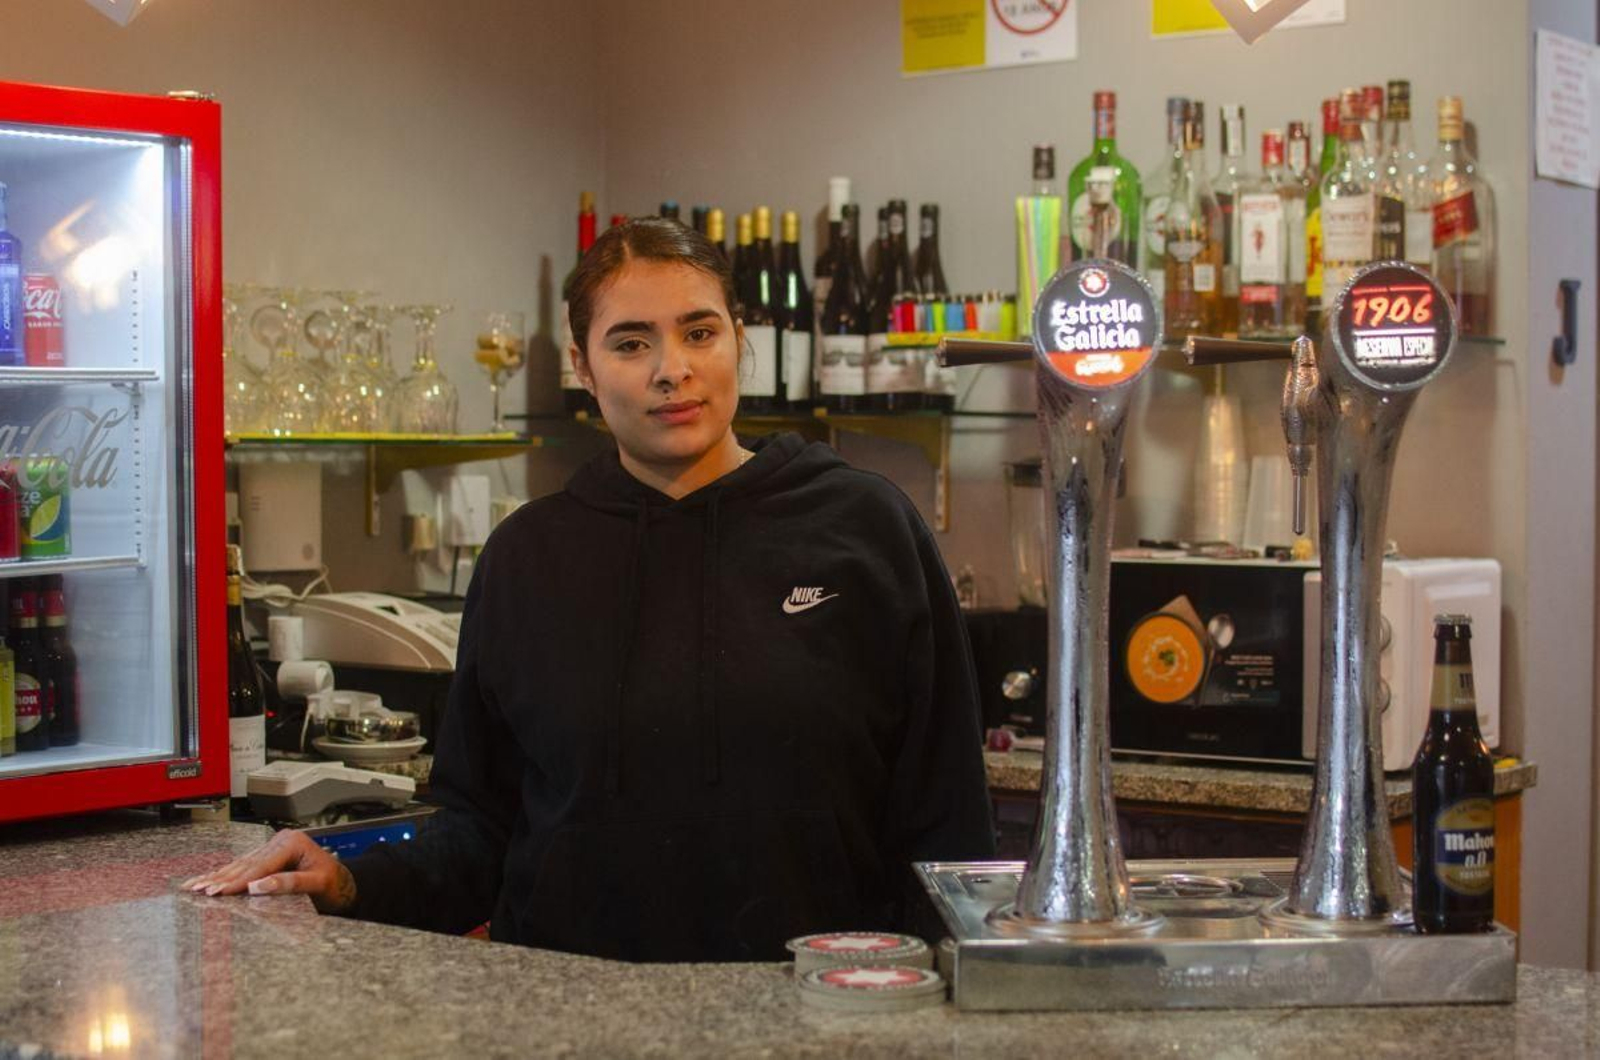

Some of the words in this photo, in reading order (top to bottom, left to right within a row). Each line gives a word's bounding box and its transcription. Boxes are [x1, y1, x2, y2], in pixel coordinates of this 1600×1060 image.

[1051, 299, 1143, 326] Estrella
[1353, 293, 1432, 327] 1906
[1055, 323, 1141, 352] Galicia
[790, 586, 823, 602] NIKE
